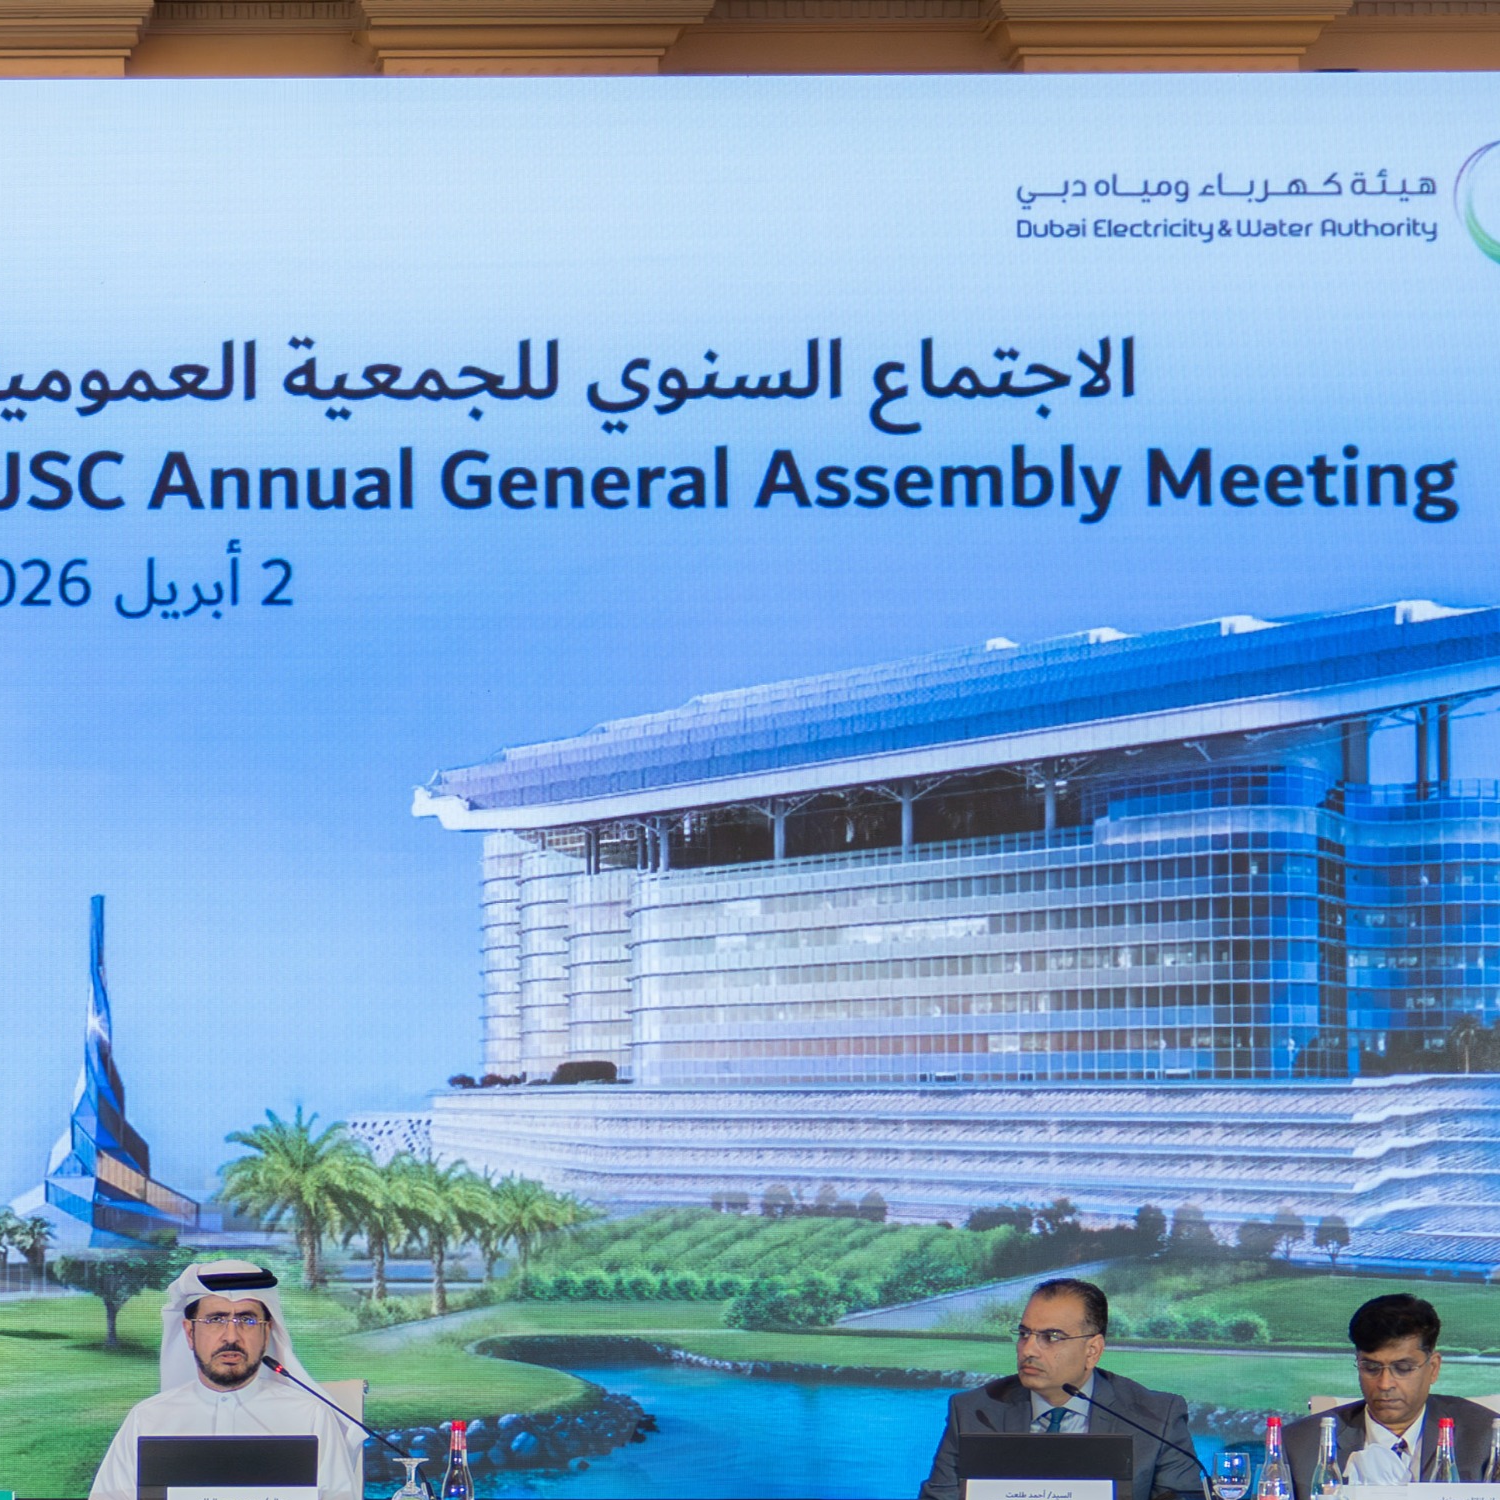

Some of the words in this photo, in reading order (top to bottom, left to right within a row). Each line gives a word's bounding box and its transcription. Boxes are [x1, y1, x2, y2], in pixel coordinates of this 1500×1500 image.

[1016, 179, 1087, 211] دبي
[1094, 173, 1190, 204] ومياه
[1198, 171, 1343, 204] كهرباء
[1350, 168, 1437, 203] هيئة
[1016, 218, 1087, 239] Dubai
[1093, 218, 1214, 244] Electricity
[1217, 219, 1232, 238] &
[1236, 219, 1314, 238] Water
[1320, 217, 1438, 243] Authority
[282, 336, 559, 422] للجمعية
[586, 337, 842, 435] السنوي
[868, 335, 1135, 436] الاجتماع
[147, 446, 414, 511] Annual
[440, 444, 729, 511] General
[753, 443, 1122, 525] Assembly
[1147, 444, 1460, 524] Meeting
[114, 538, 242, 620] أبريل
[261, 557, 294, 607] 2
[1029, 1489, 1046, 1499] أحمد
